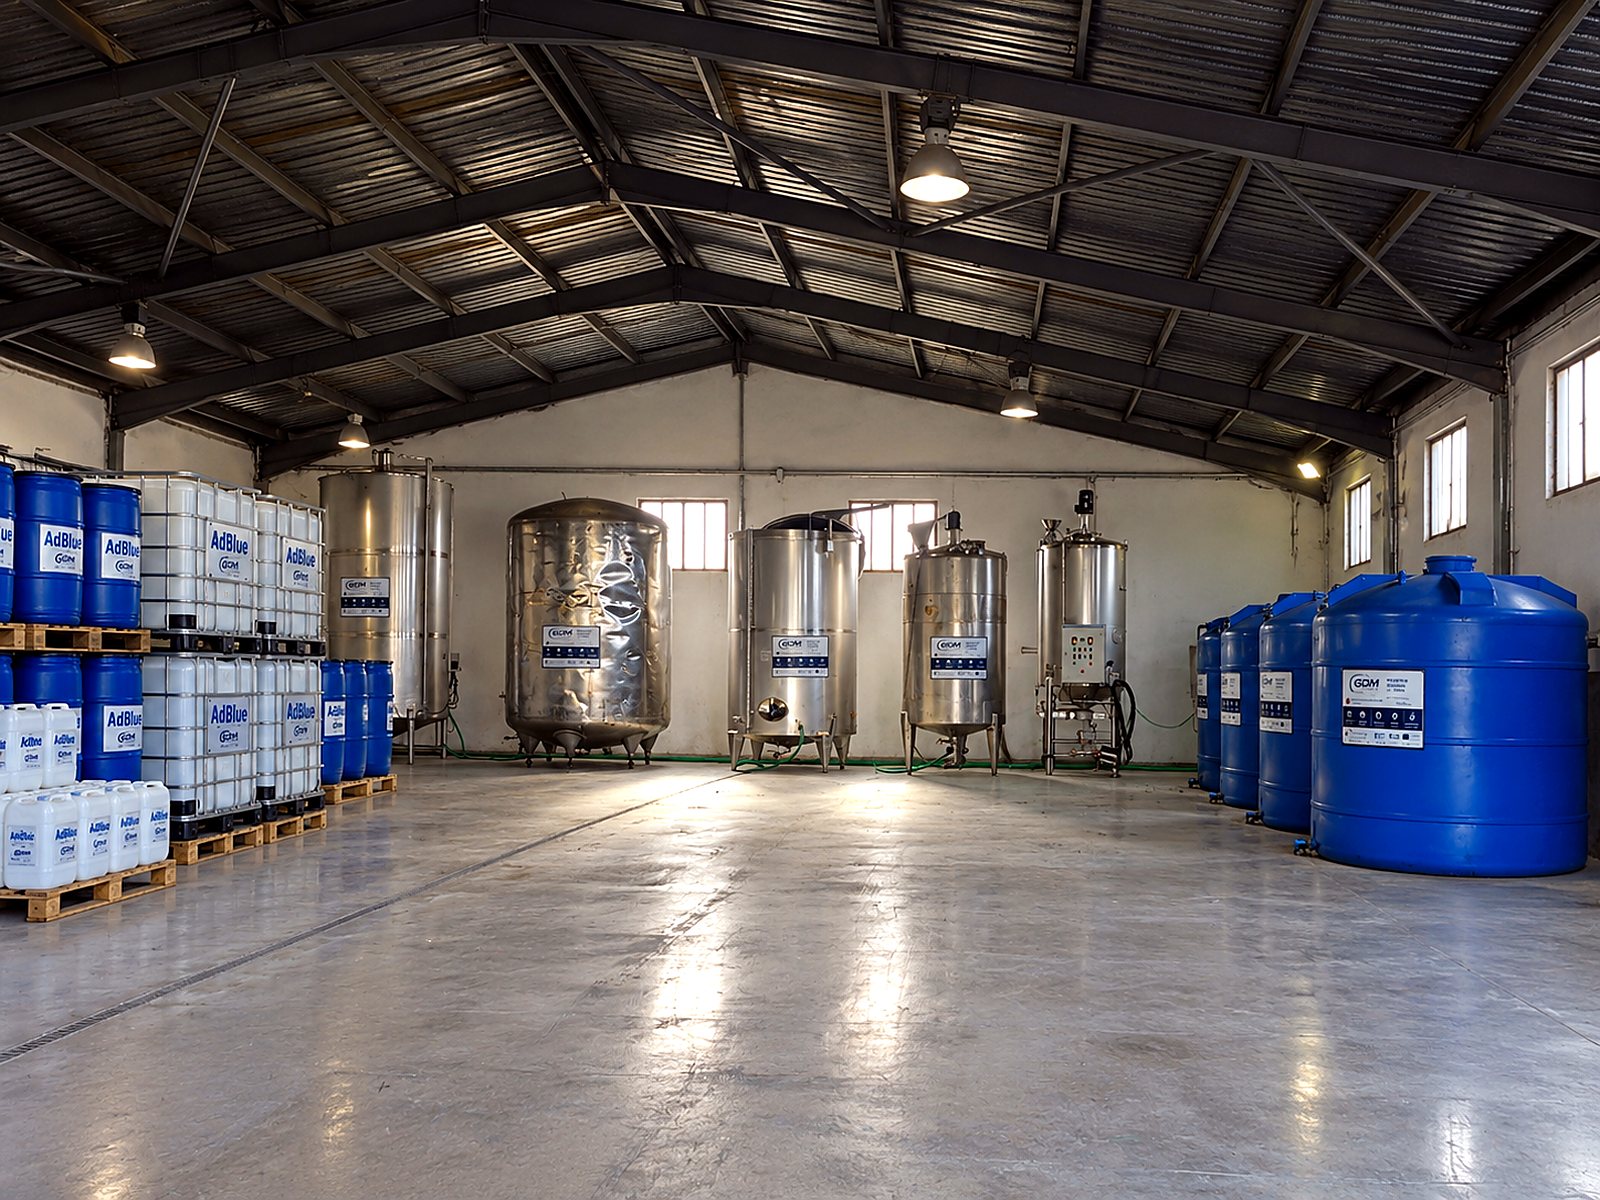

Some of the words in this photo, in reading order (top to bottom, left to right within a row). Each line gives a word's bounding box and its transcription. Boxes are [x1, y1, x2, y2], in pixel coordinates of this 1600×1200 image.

[44, 531, 82, 550] AdBlue
[105, 539, 140, 558] AdBlue
[210, 530, 249, 555] AdBlue
[286, 547, 316, 567] AdBlue
[1353, 678, 1380, 688] GDM
[107, 710, 142, 727] AdBlue
[210, 704, 248, 724] AdBlue
[287, 702, 315, 720] AdBlue
